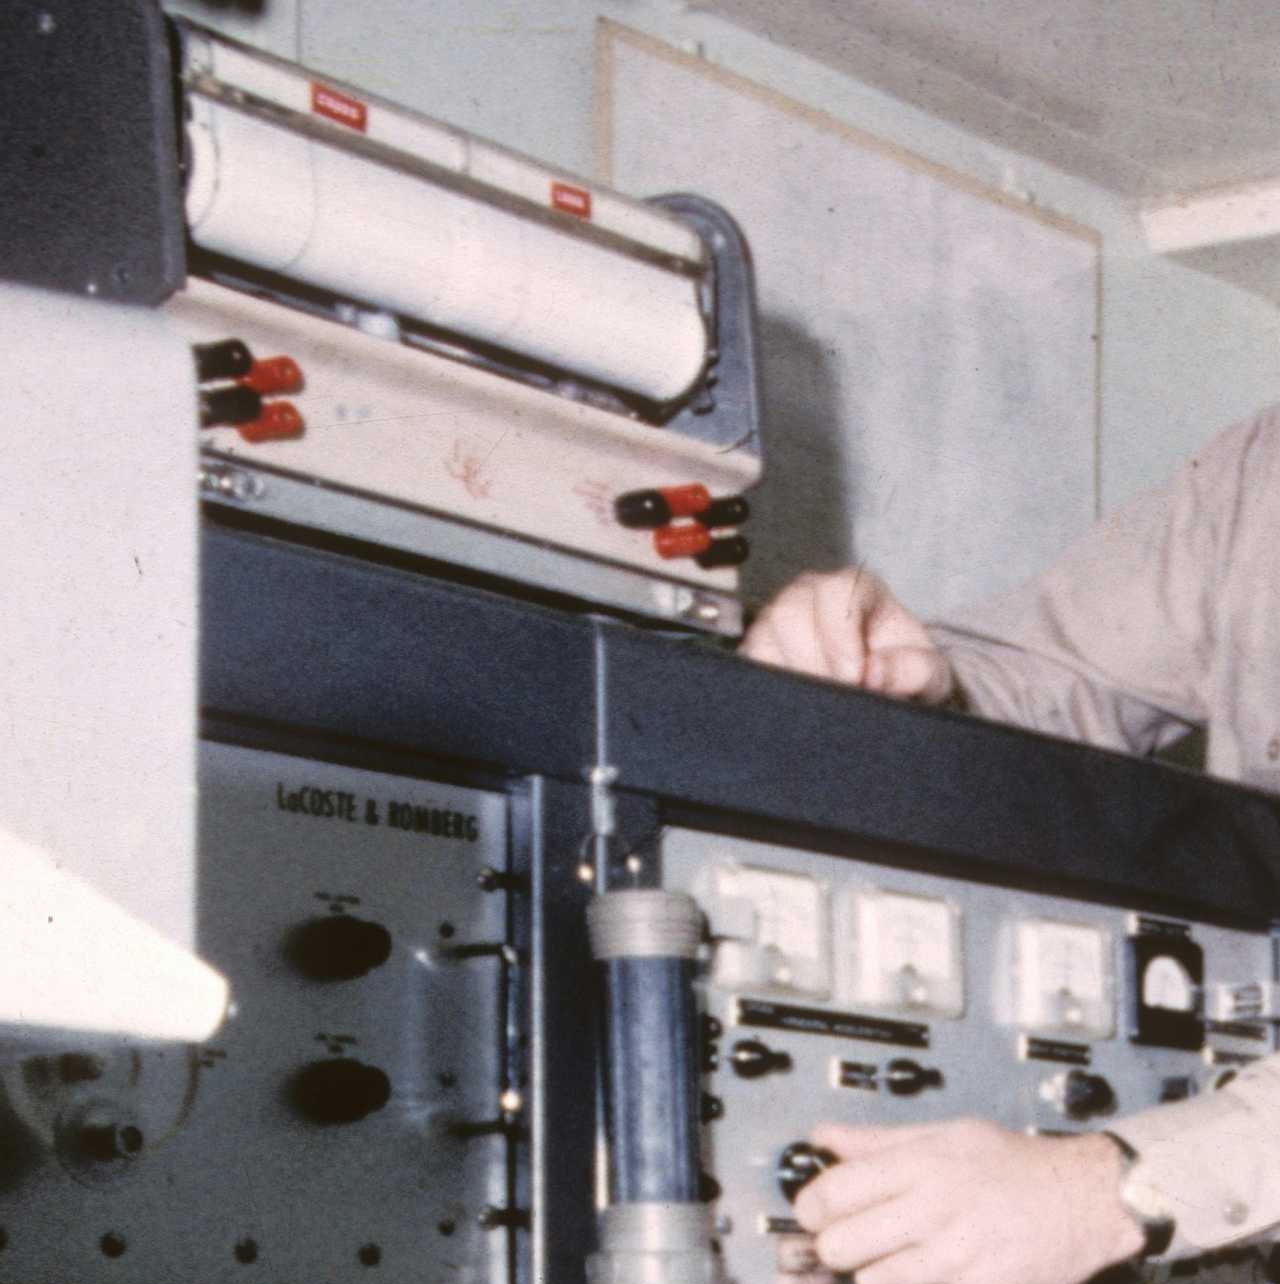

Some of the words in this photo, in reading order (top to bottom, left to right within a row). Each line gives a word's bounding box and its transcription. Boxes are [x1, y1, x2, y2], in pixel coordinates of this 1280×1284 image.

[276, 783, 357, 822] LaCOSTE
[365, 798, 378, 826] &
[387, 800, 480, 842] ROMBERG
